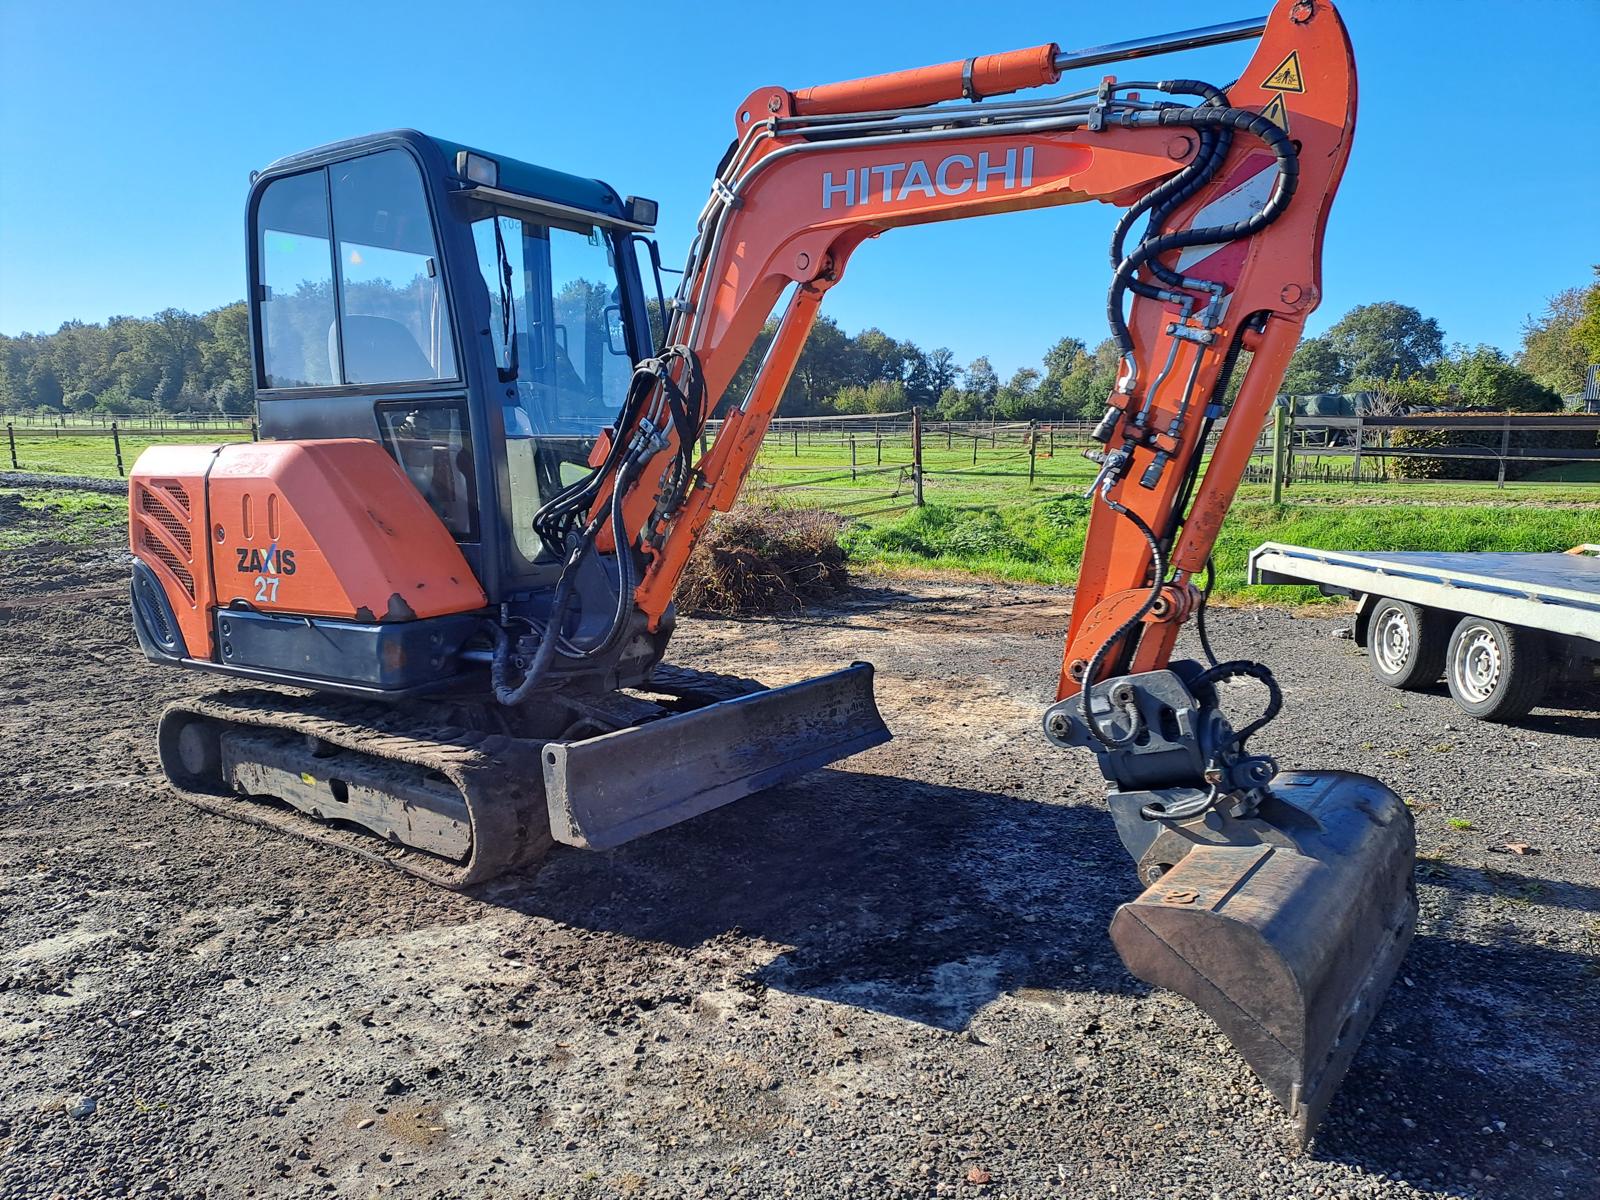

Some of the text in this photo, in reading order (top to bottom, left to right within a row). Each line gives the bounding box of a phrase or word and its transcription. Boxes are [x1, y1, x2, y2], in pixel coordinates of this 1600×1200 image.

[822, 146, 1034, 209] HITACHI
[236, 543, 296, 576] ZAXIS
[255, 575, 279, 602] 27
